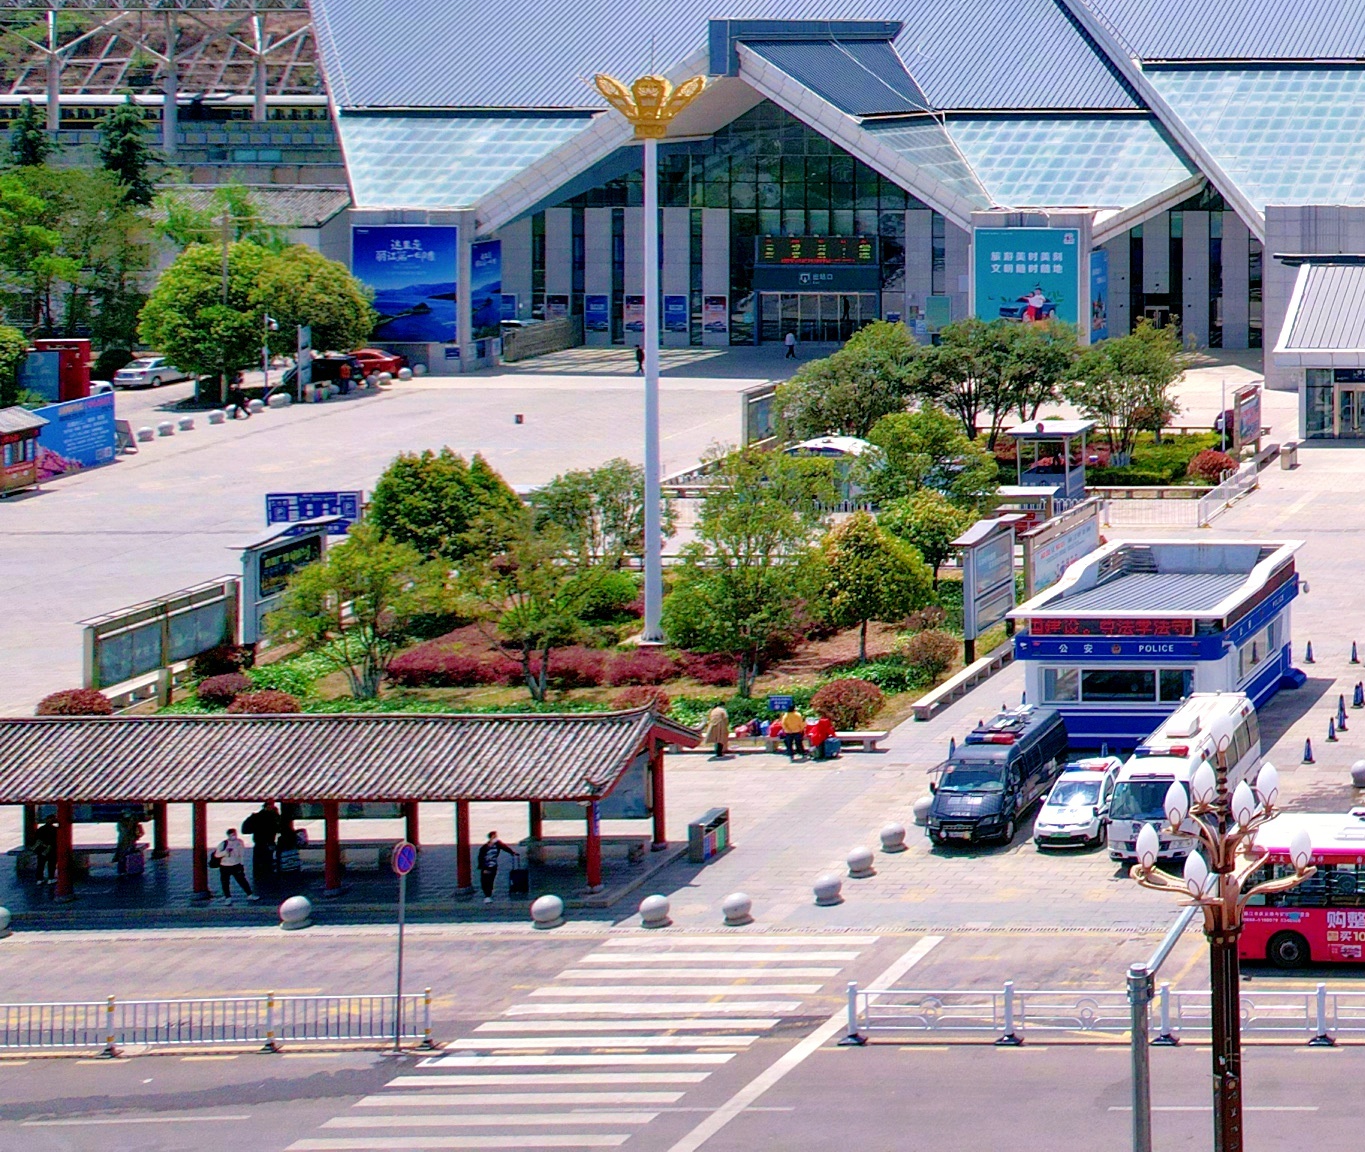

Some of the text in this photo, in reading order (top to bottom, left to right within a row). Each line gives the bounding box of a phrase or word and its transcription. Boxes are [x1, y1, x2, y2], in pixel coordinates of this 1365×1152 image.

[390, 239, 423, 251] 这里是
[1058, 644, 1093, 654] 公安
[1138, 644, 1174, 653] POLICE
